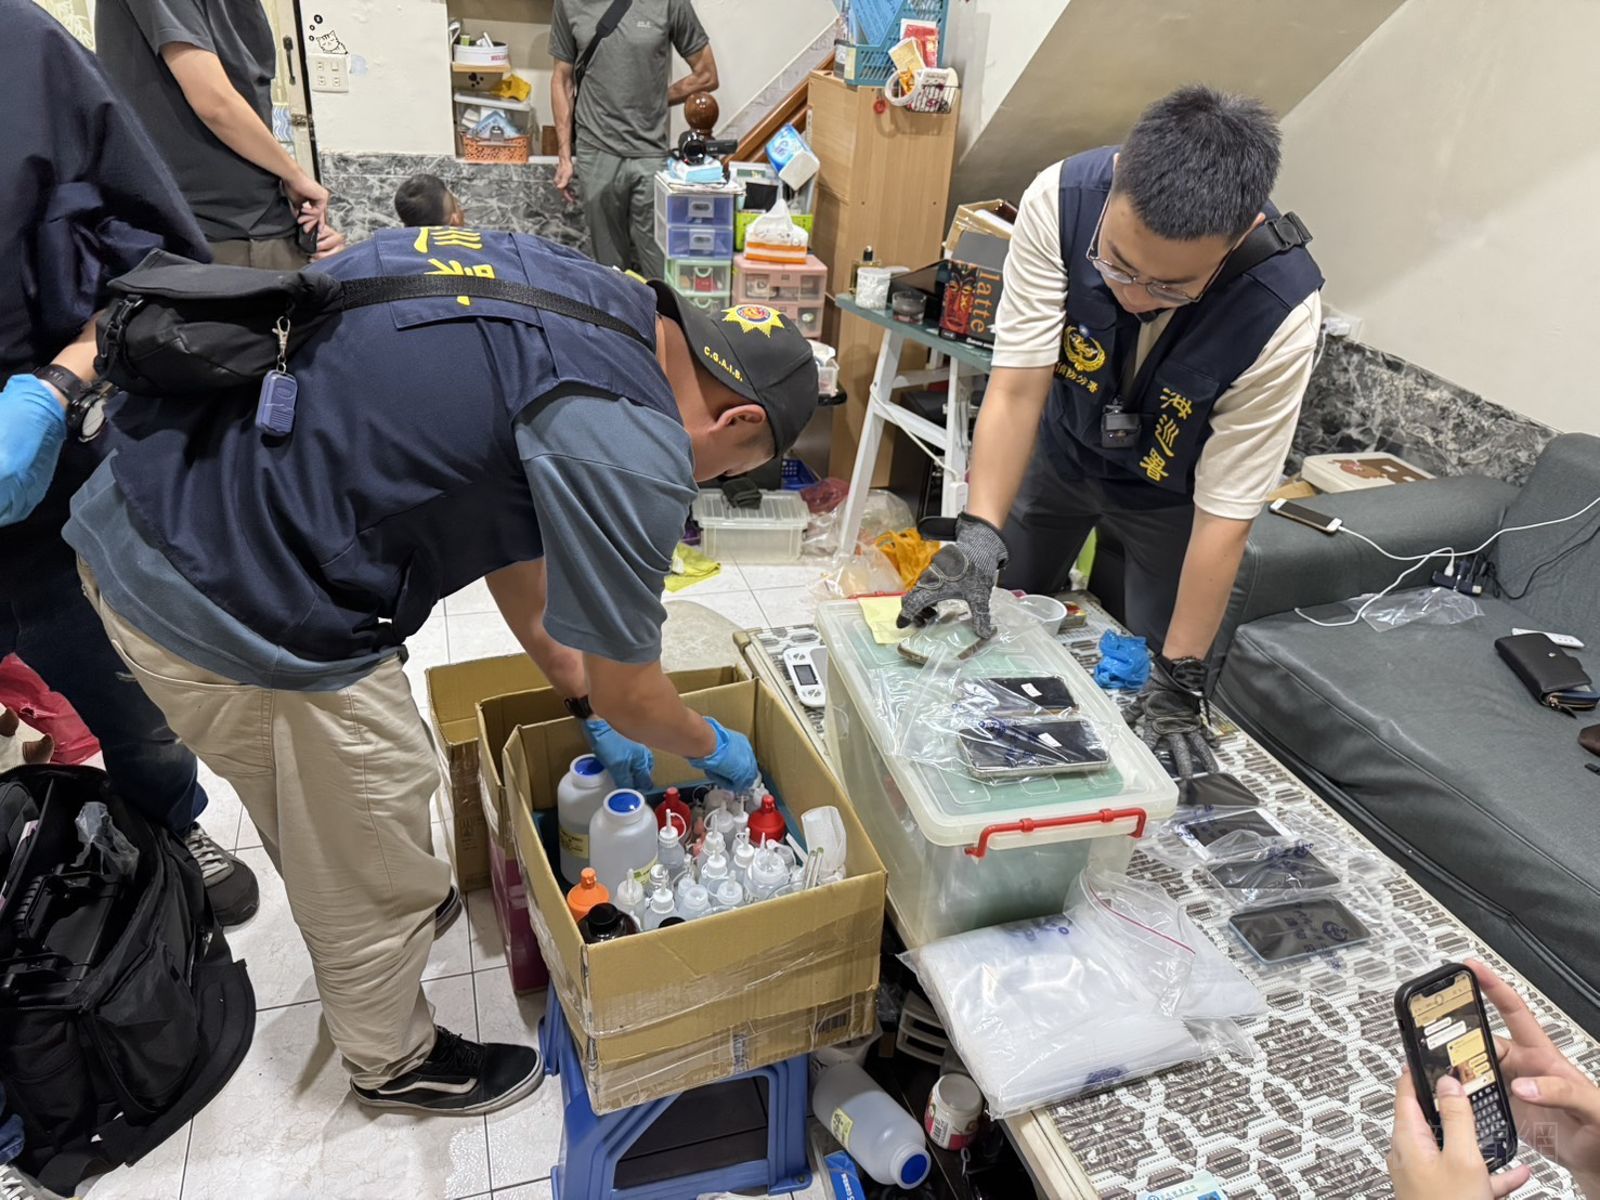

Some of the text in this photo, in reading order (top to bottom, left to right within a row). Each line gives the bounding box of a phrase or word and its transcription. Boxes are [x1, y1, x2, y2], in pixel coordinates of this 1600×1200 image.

[970, 271, 1000, 333] latte
[1139, 387, 1193, 483] 海巡署
